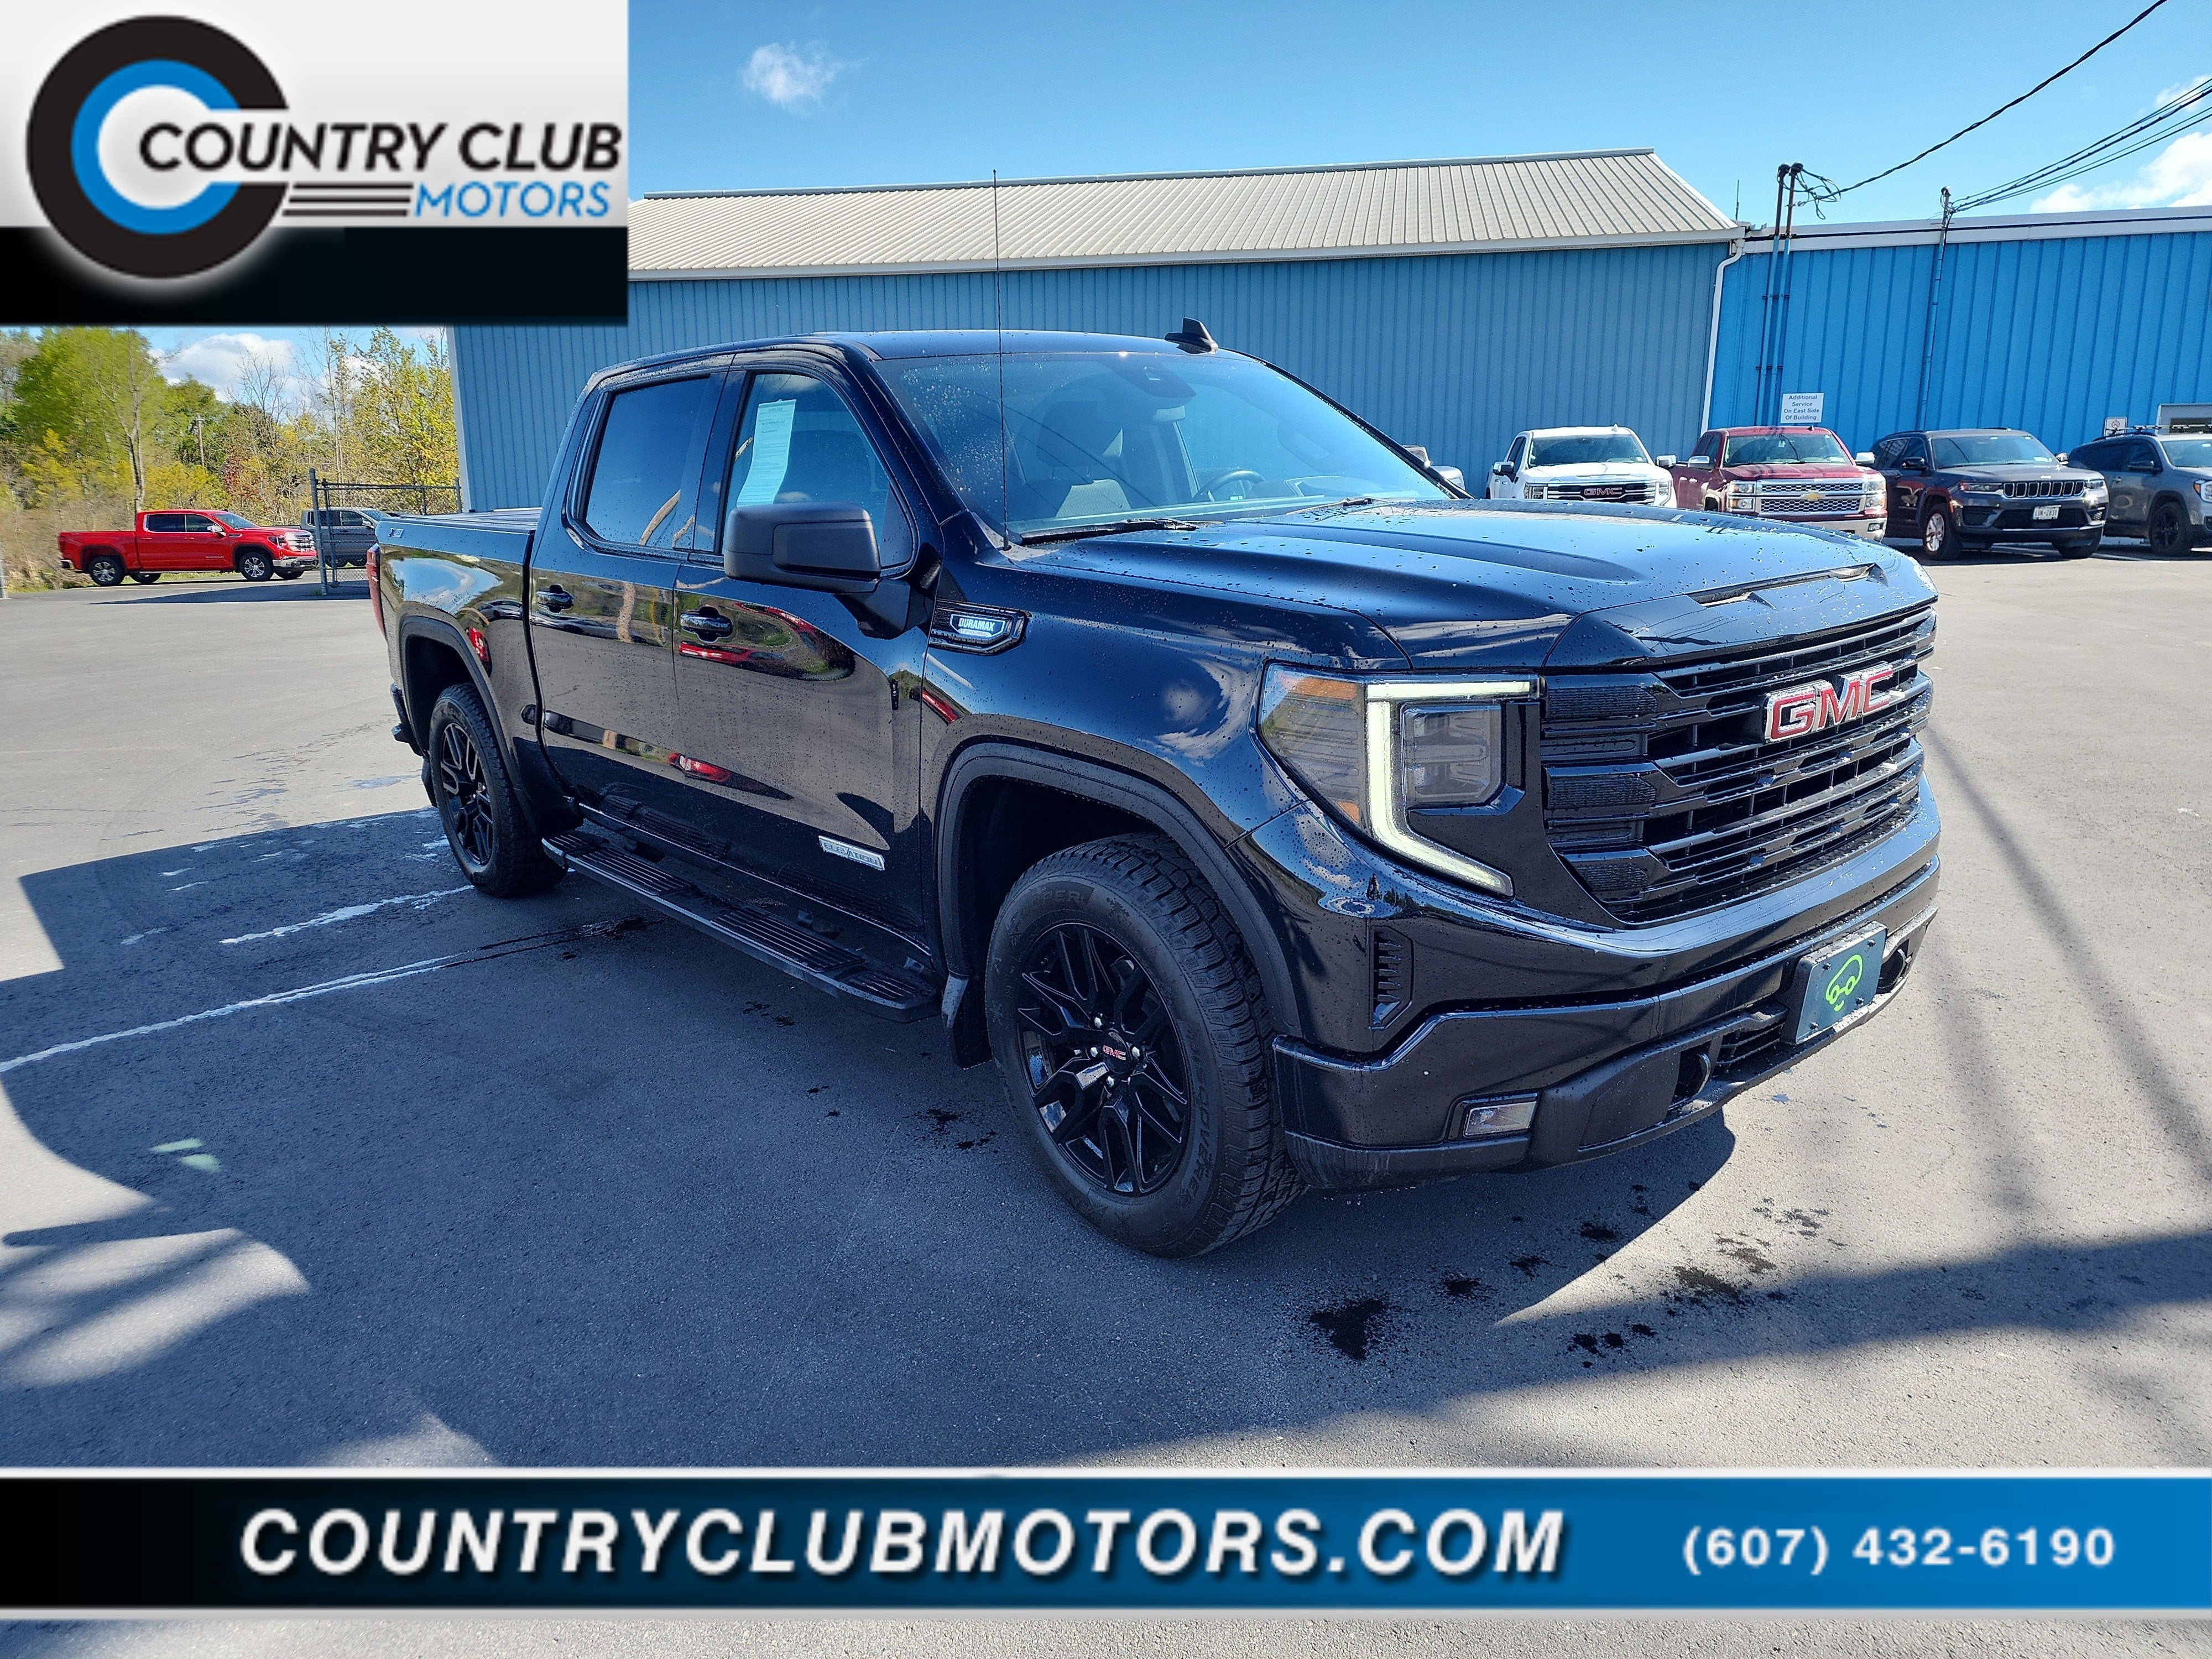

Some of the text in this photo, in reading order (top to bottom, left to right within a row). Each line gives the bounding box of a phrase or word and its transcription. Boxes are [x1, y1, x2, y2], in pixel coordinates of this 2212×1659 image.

[1584, 487, 1623, 495] GMC
[958, 617, 995, 632] DURAMAX
[1766, 665, 1894, 742] GMC
[823, 842, 877, 865] ELEVATION
[1103, 1044, 1126, 1061] GMC
